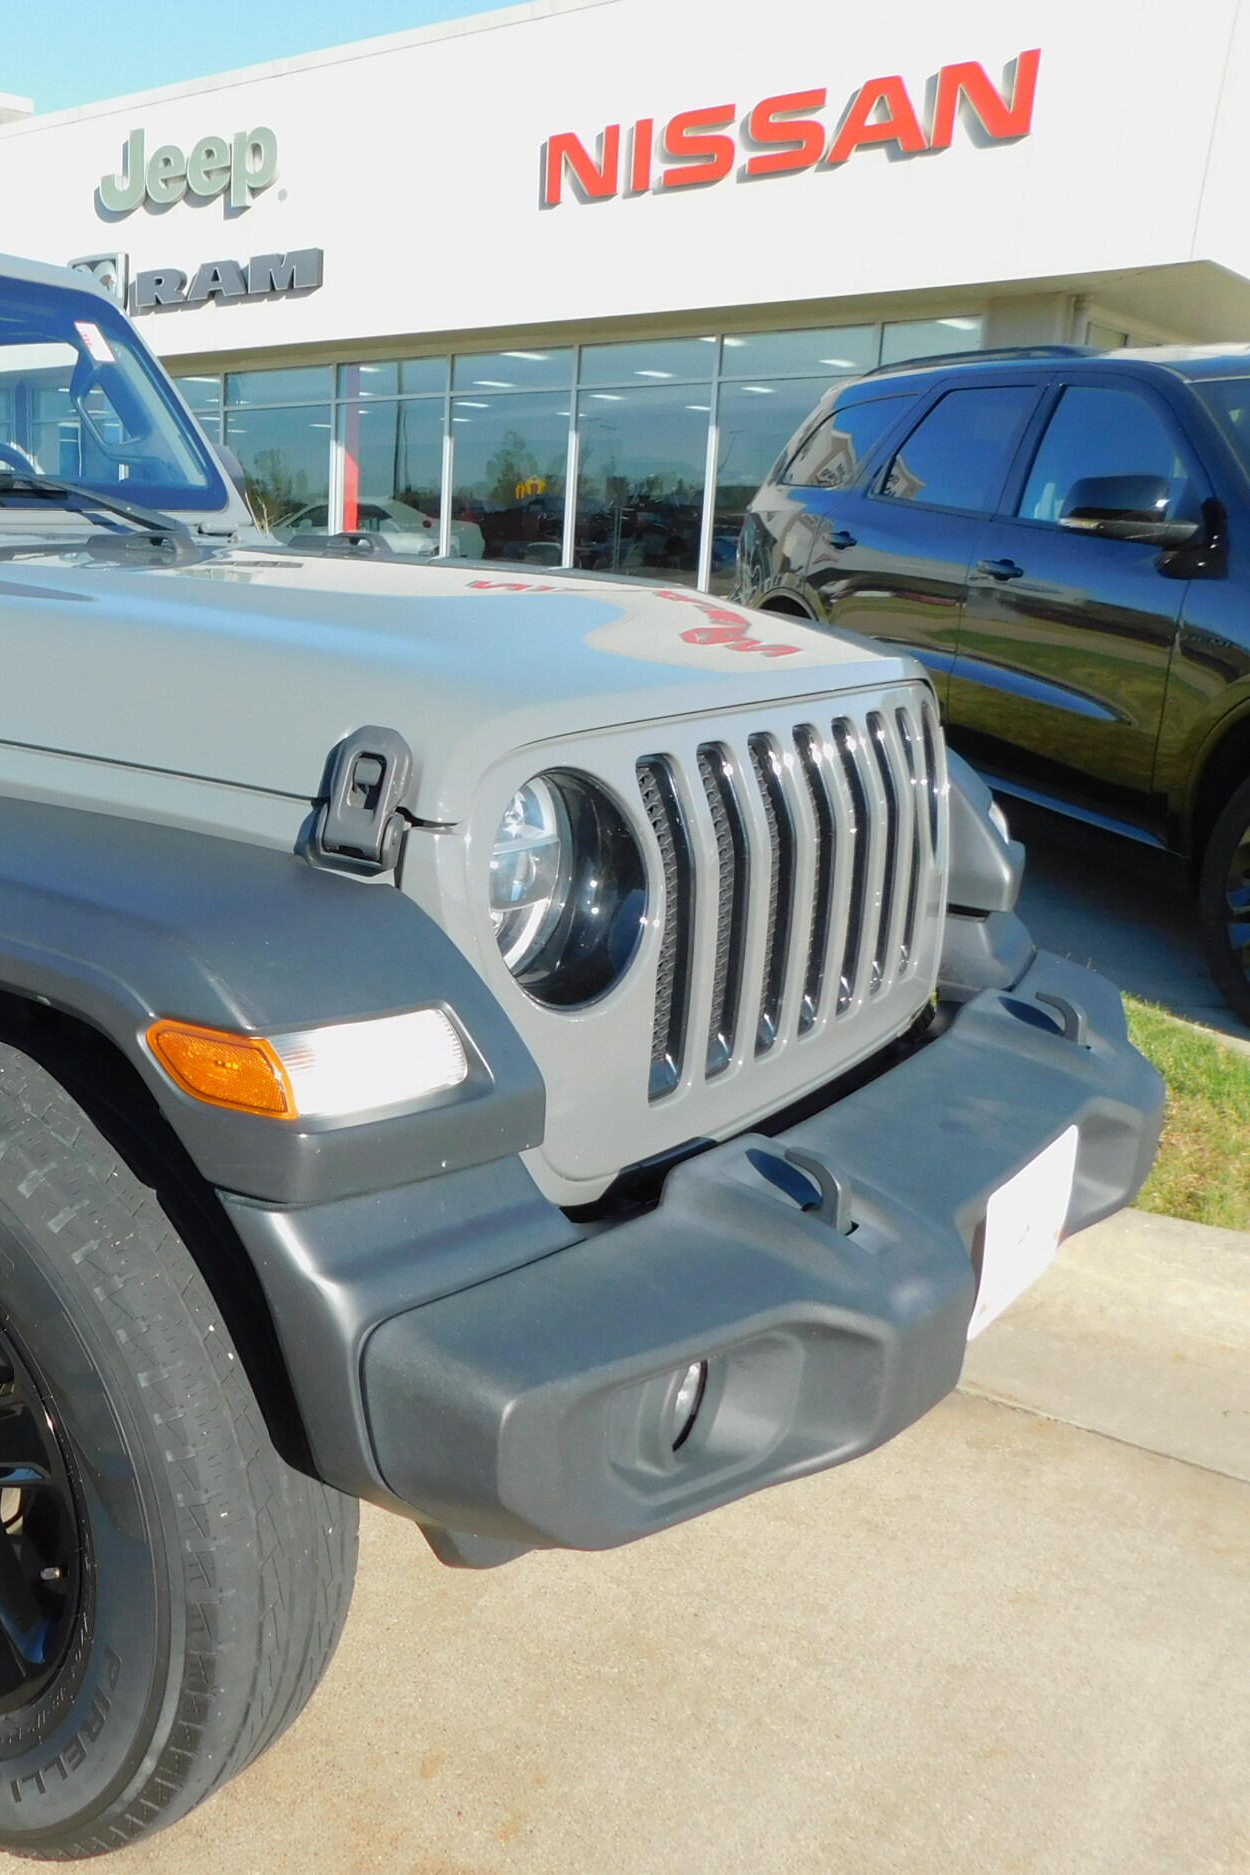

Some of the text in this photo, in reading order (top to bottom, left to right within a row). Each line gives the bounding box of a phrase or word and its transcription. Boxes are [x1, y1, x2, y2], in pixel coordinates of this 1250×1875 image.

[97, 125, 279, 214] Jeep
[543, 47, 1041, 206] NISSAN
[134, 248, 324, 308] RAM
[9, 1644, 123, 1803] PIRELLI
